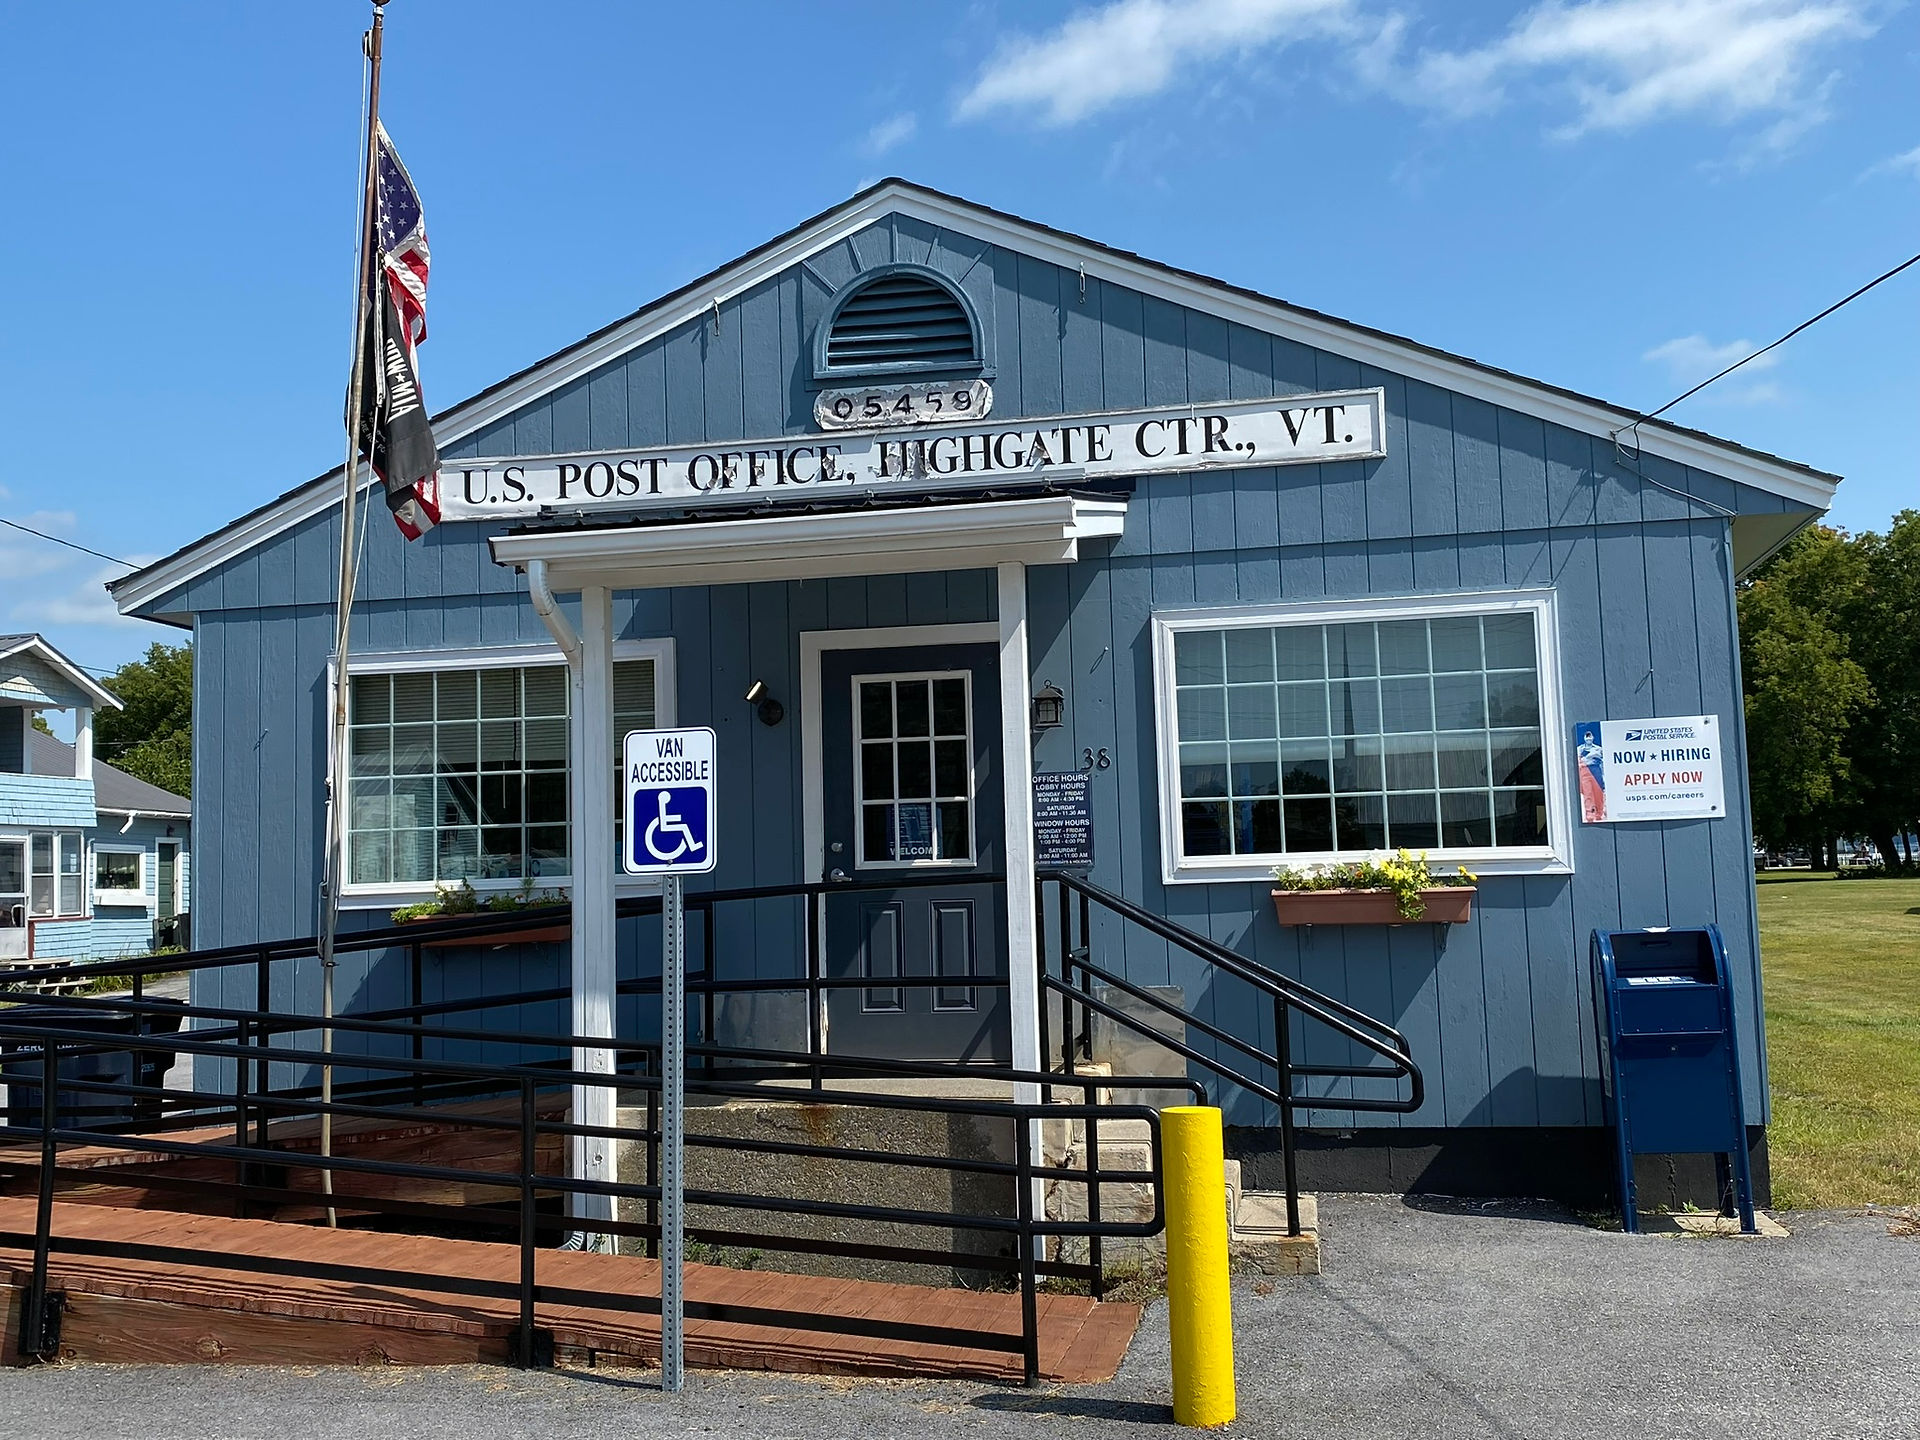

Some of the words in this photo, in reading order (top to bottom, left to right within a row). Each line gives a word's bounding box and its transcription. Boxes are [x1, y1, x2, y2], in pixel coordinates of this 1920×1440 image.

[386, 380, 420, 424] MIA
[834, 390, 972, 420] 05459
[460, 466, 534, 504] U.S.
[556, 458, 668, 500] POST
[688, 444, 856, 490] OFFICE,
[874, 424, 1113, 480] HIGHGATE
[1134, 414, 1256, 458] CTR.,
[1277, 405, 1354, 446] VT.
[656, 738, 683, 758] VAN
[1081, 747, 1111, 771] 38
[1613, 750, 1646, 764] NOW
[1661, 747, 1711, 761] HIRING
[632, 760, 708, 783] ACCESSIBLE
[1624, 772, 1666, 786] APPLY
[1672, 771, 1703, 784] NOW
[1626, 791, 1704, 802] usps.com/careers
